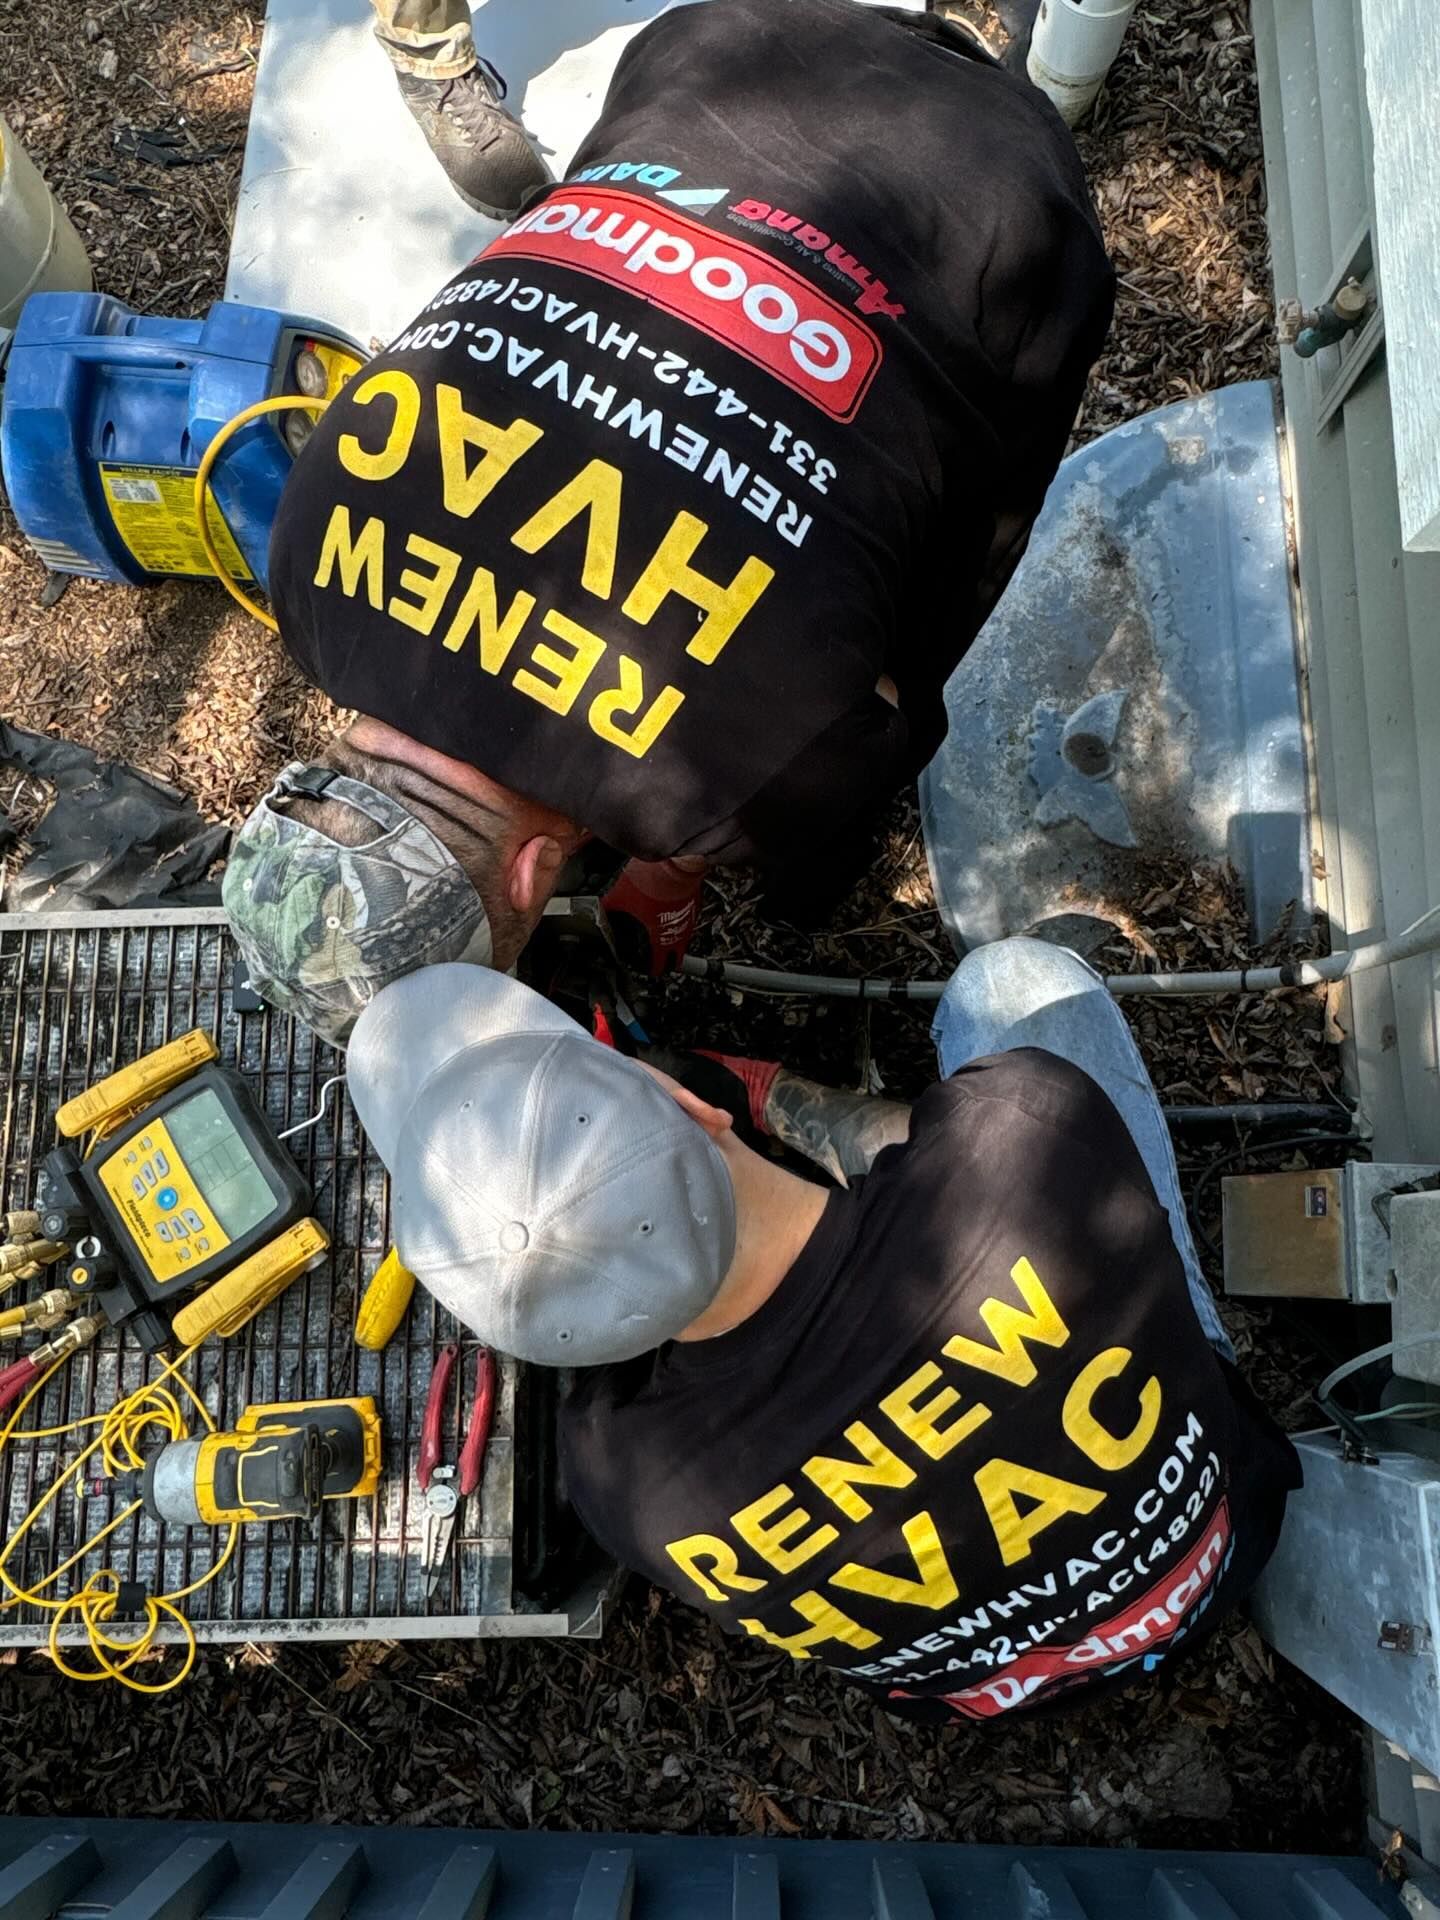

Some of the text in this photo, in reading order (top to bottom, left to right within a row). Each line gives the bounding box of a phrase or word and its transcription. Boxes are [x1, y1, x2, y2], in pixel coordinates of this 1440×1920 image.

[568, 162, 683, 188] DAIK
[725, 212, 794, 247] Conditioning
[730, 198, 905, 319] Amana
[792, 243, 811, 257] Air
[822, 262, 859, 294] Heating
[338, 370, 776, 666] HVAC
[396, 319, 813, 547] RENEWHVAC.COM
[313, 505, 686, 759] RENEW
[664, 1255, 1071, 1602] RENEW
[738, 1346, 1162, 1660] HVAC
[830, 1411, 1204, 1678] ENEWHVAC.COM
